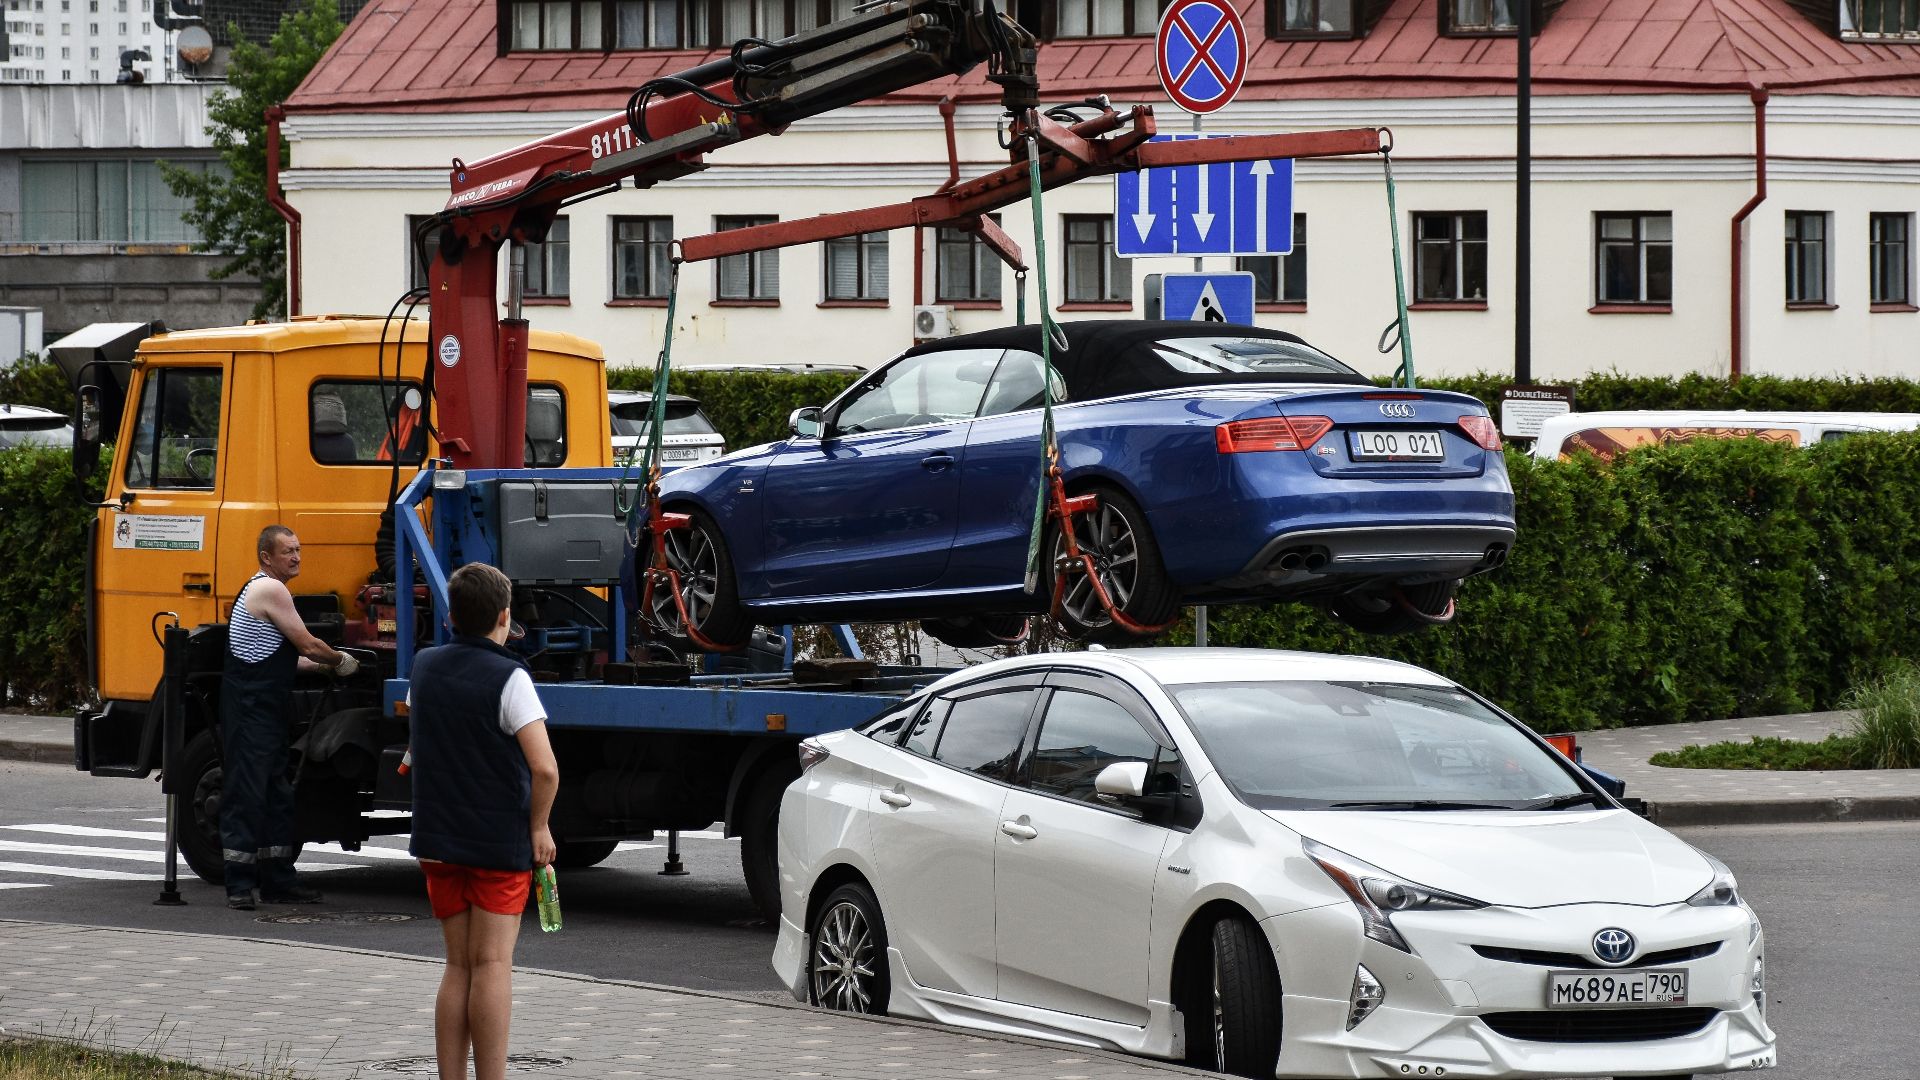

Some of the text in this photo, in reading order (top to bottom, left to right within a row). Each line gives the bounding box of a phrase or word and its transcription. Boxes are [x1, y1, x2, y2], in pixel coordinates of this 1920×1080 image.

[591, 124, 632, 159] 811T
[451, 191, 476, 206] AMCO
[492, 179, 513, 192] VEBA
[1360, 433, 1439, 454] LOO 021
[1648, 974, 1682, 994] 790
[1656, 994, 1673, 1002] RUS
